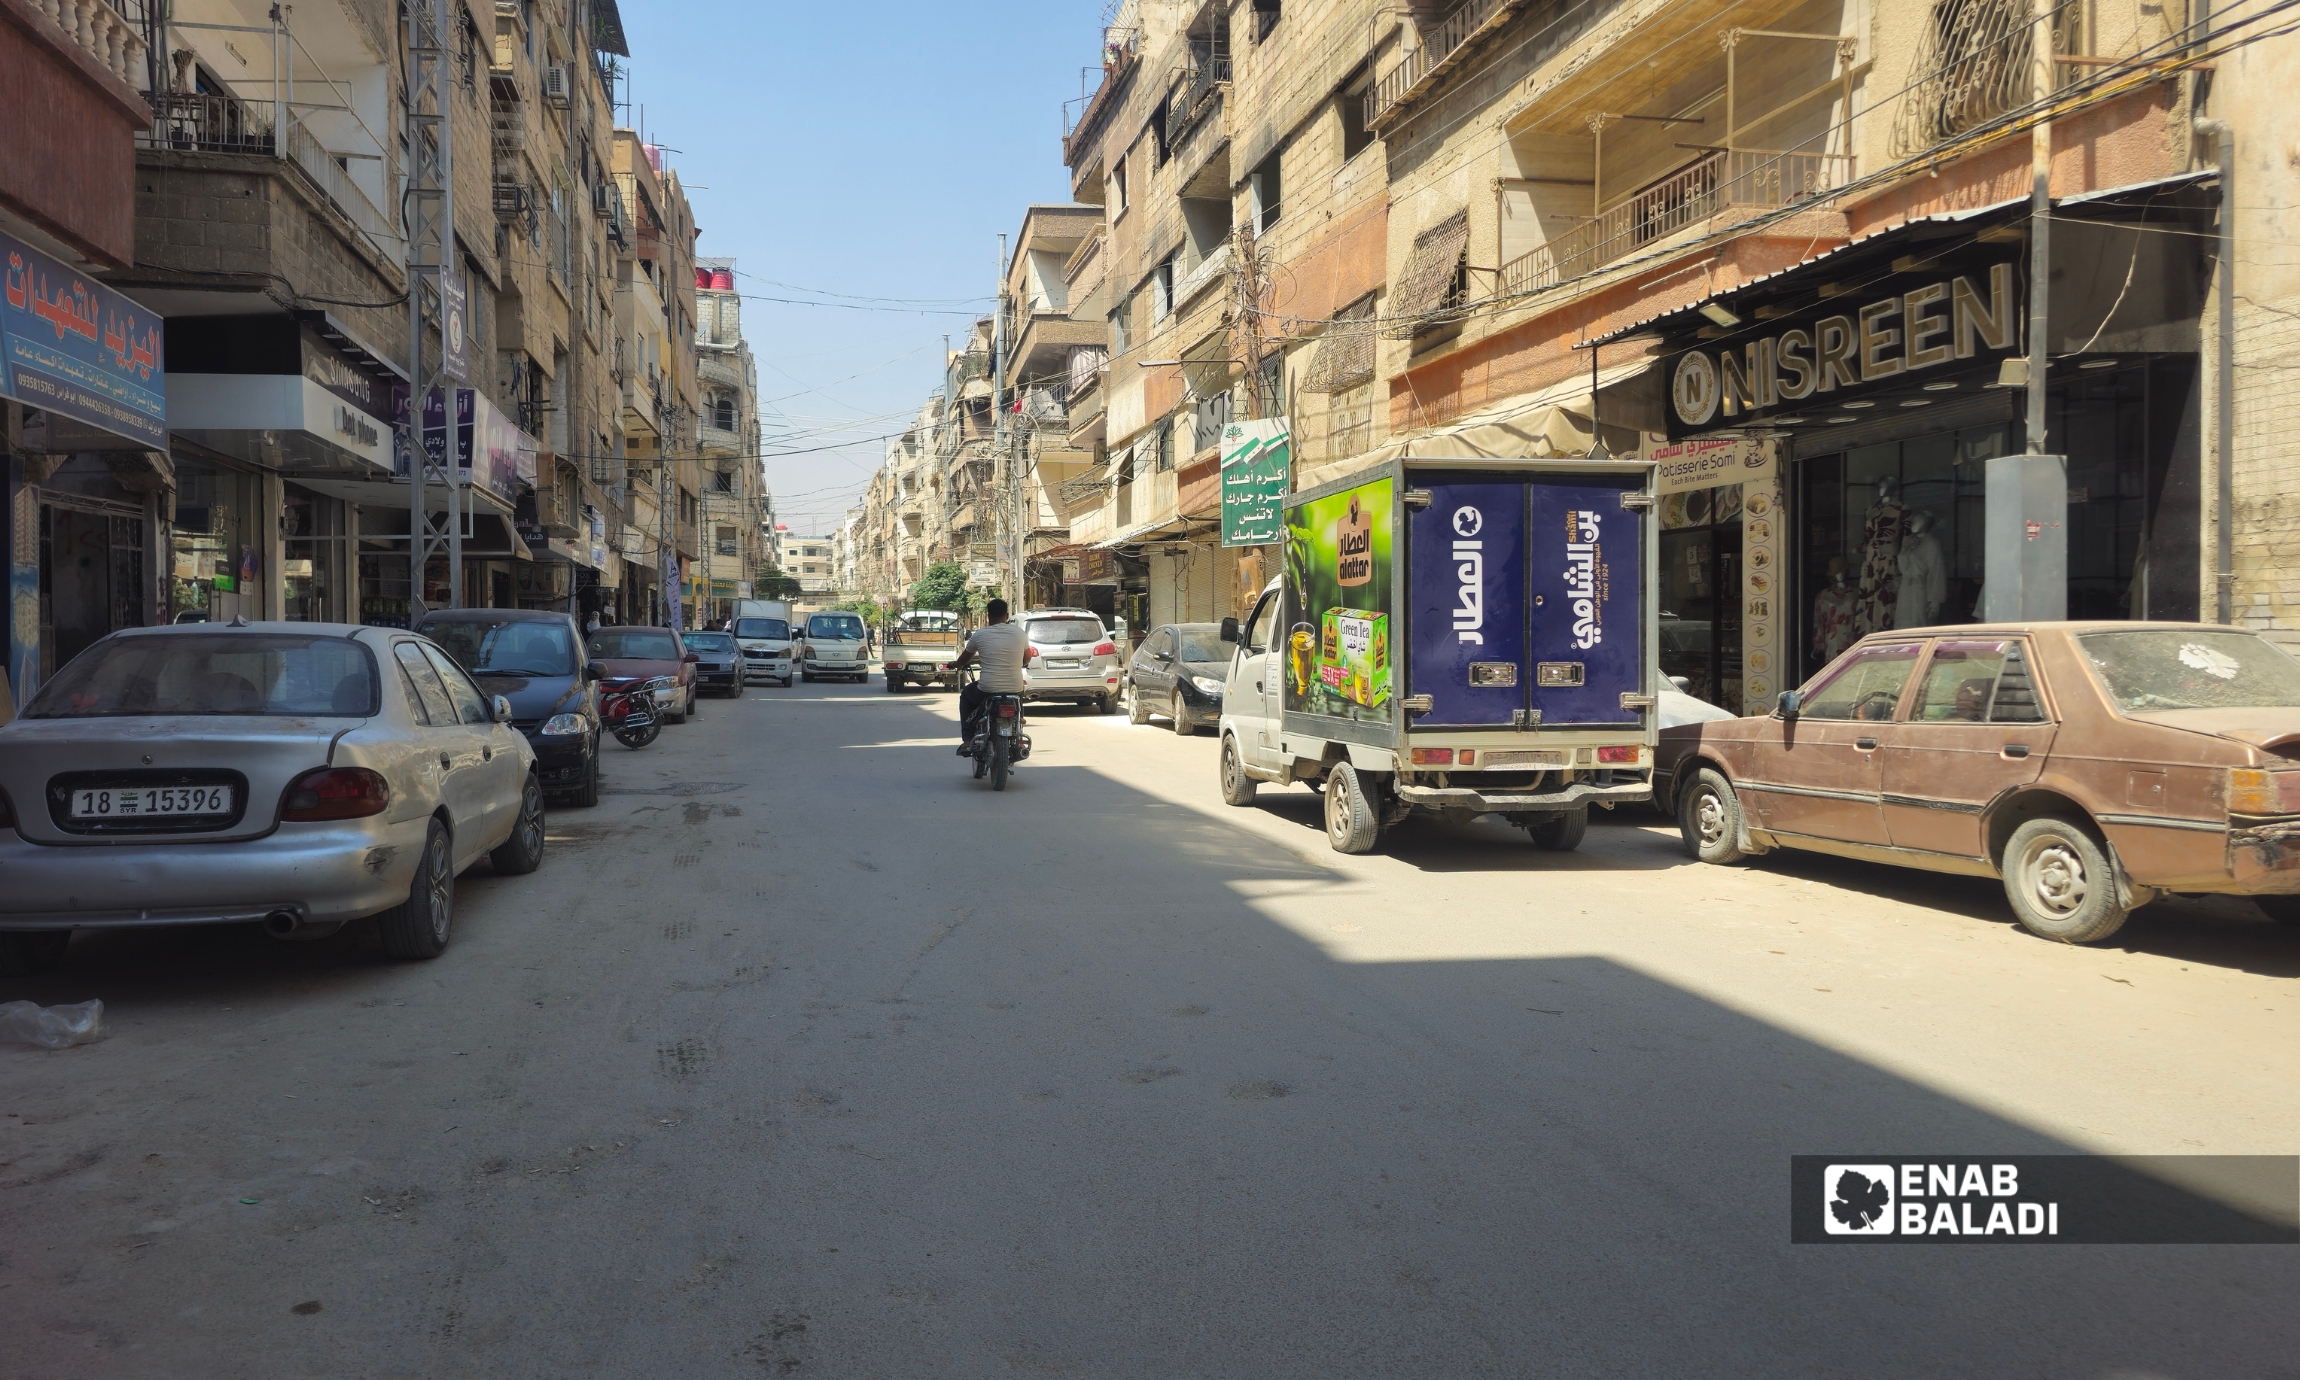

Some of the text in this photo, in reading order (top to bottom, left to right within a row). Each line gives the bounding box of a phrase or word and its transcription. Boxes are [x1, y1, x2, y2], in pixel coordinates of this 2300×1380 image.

[6, 251, 161, 381] اليزيد للتعهدات
[1721, 263, 2014, 417] NISREEN
[18, 373, 56, 396] 0935815763
[1711, 451, 1736, 470] Sami
[1671, 472, 1718, 486] Each Bite Matters
[1568, 510, 1577, 543] Shami
[1339, 528, 1370, 558] العطار
[1339, 556, 1370, 581] alattar
[1452, 541, 1483, 646] العطار
[1562, 543, 1602, 650] الشامي
[1341, 619, 1370, 639] Green Tea
[82, 791, 111, 814] 18
[145, 789, 221, 813] 15396
